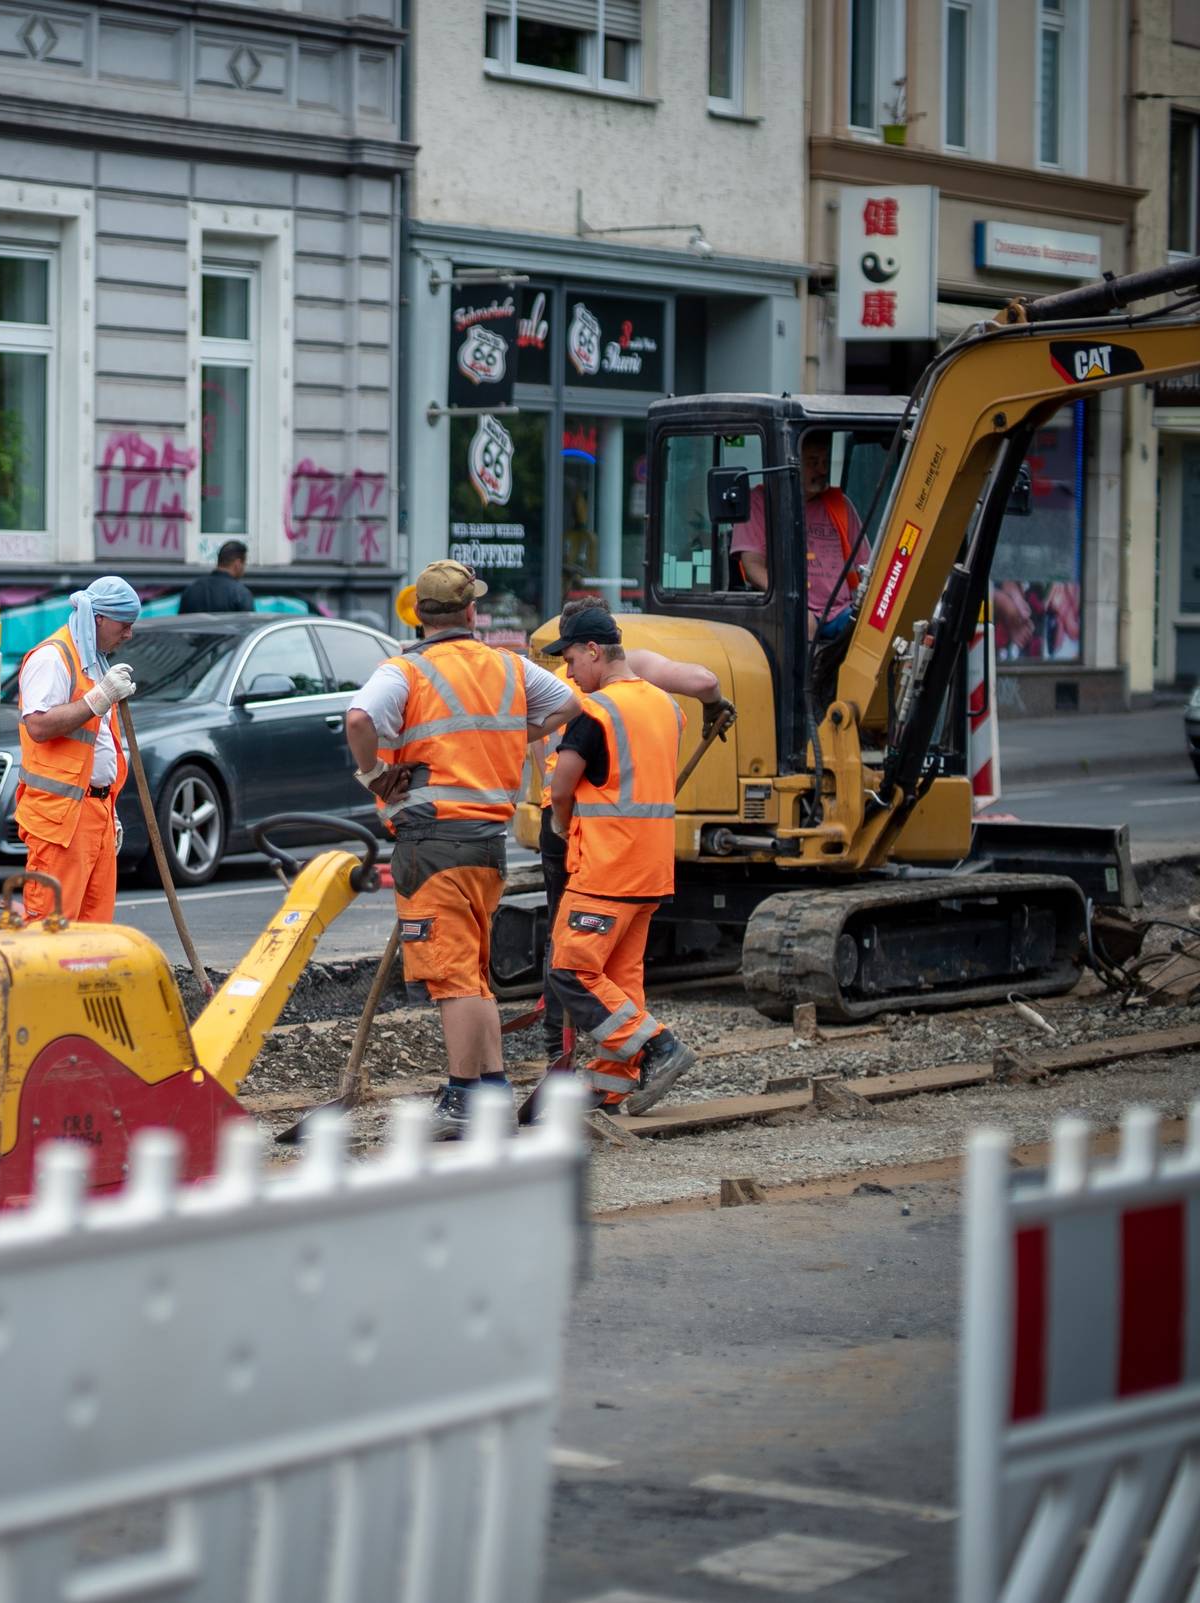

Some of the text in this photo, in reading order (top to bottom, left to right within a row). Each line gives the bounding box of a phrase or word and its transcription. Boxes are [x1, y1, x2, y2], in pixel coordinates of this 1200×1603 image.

[861, 197, 899, 328] 健 康
[1074, 345, 1112, 380] CAT
[914, 488, 928, 511] hier
[452, 539, 525, 568] GEÖFFNET
[876, 560, 905, 619] ZEPPELIN
